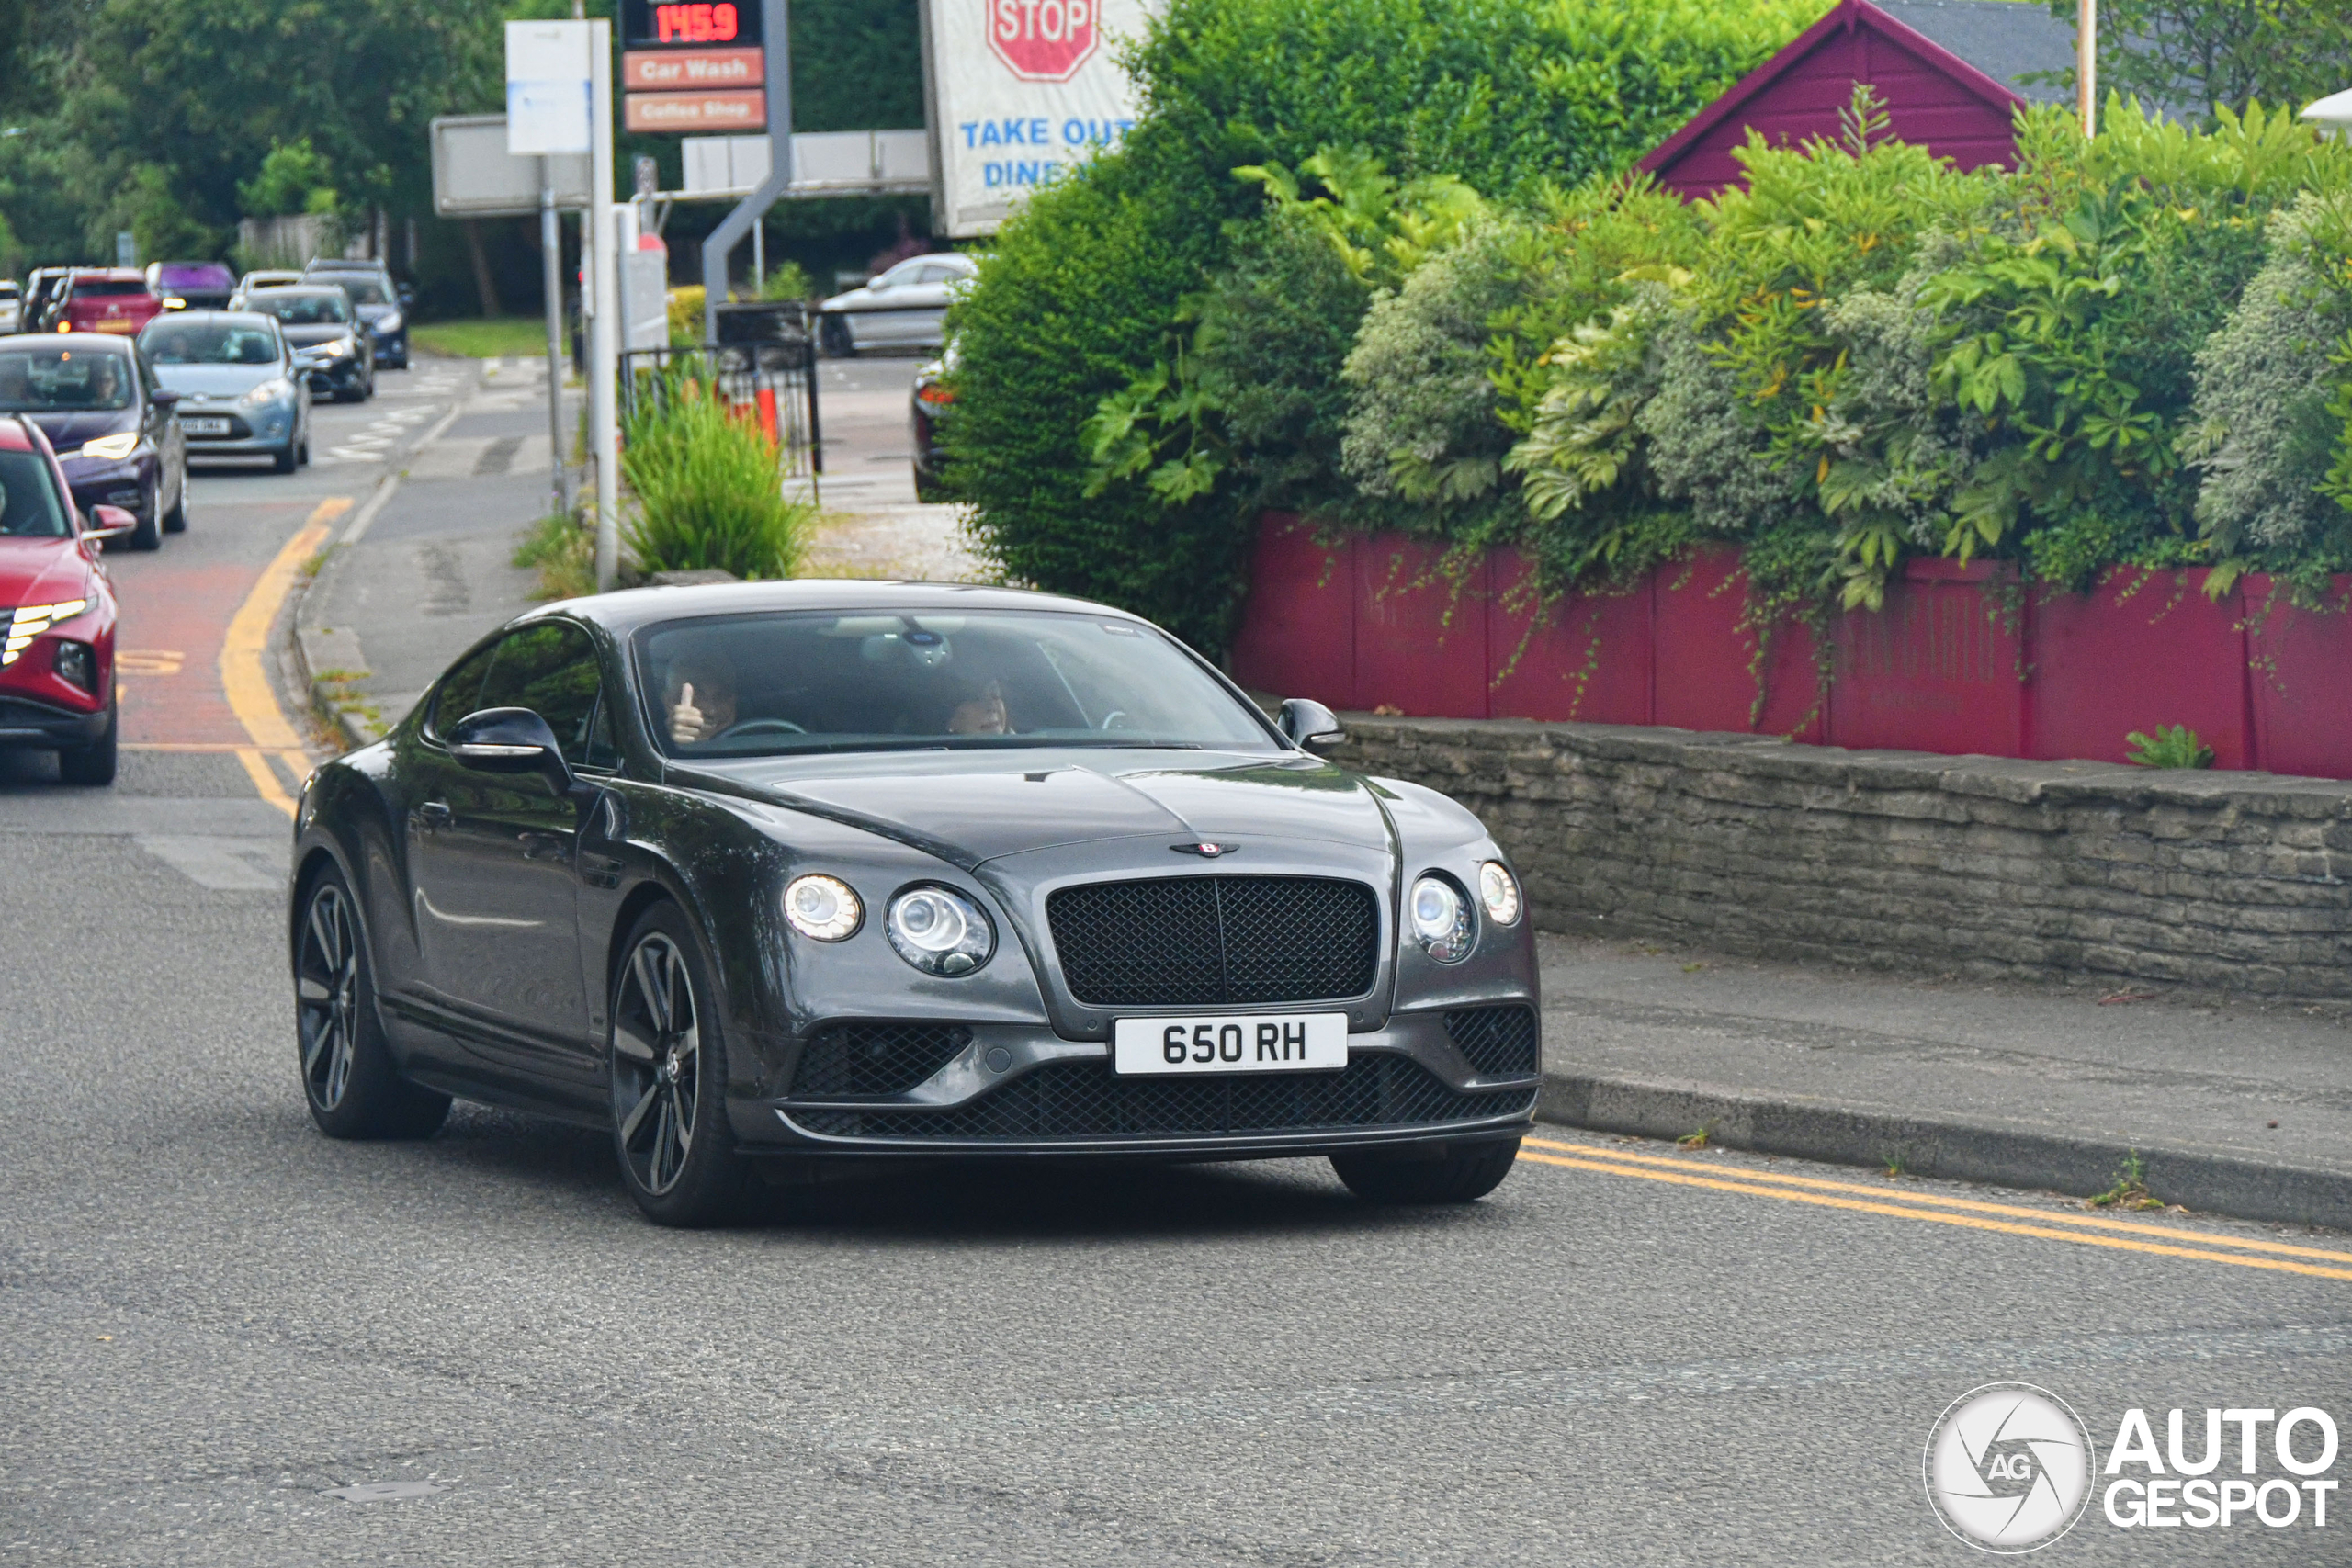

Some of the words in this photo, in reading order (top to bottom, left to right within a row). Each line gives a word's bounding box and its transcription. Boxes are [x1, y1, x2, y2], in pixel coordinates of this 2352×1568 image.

[656, 3, 738, 43] 145.9
[998, 0, 1088, 41] STOP
[640, 61, 681, 79] Car
[686, 59, 748, 77] Wash
[640, 103, 699, 118] Coffee
[704, 101, 749, 117] Shop
[960, 118, 1049, 147] TAKE
[1202, 843, 1216, 852] B
[1164, 1024, 1242, 1064] 650
[1257, 1022, 1306, 1061] RH
